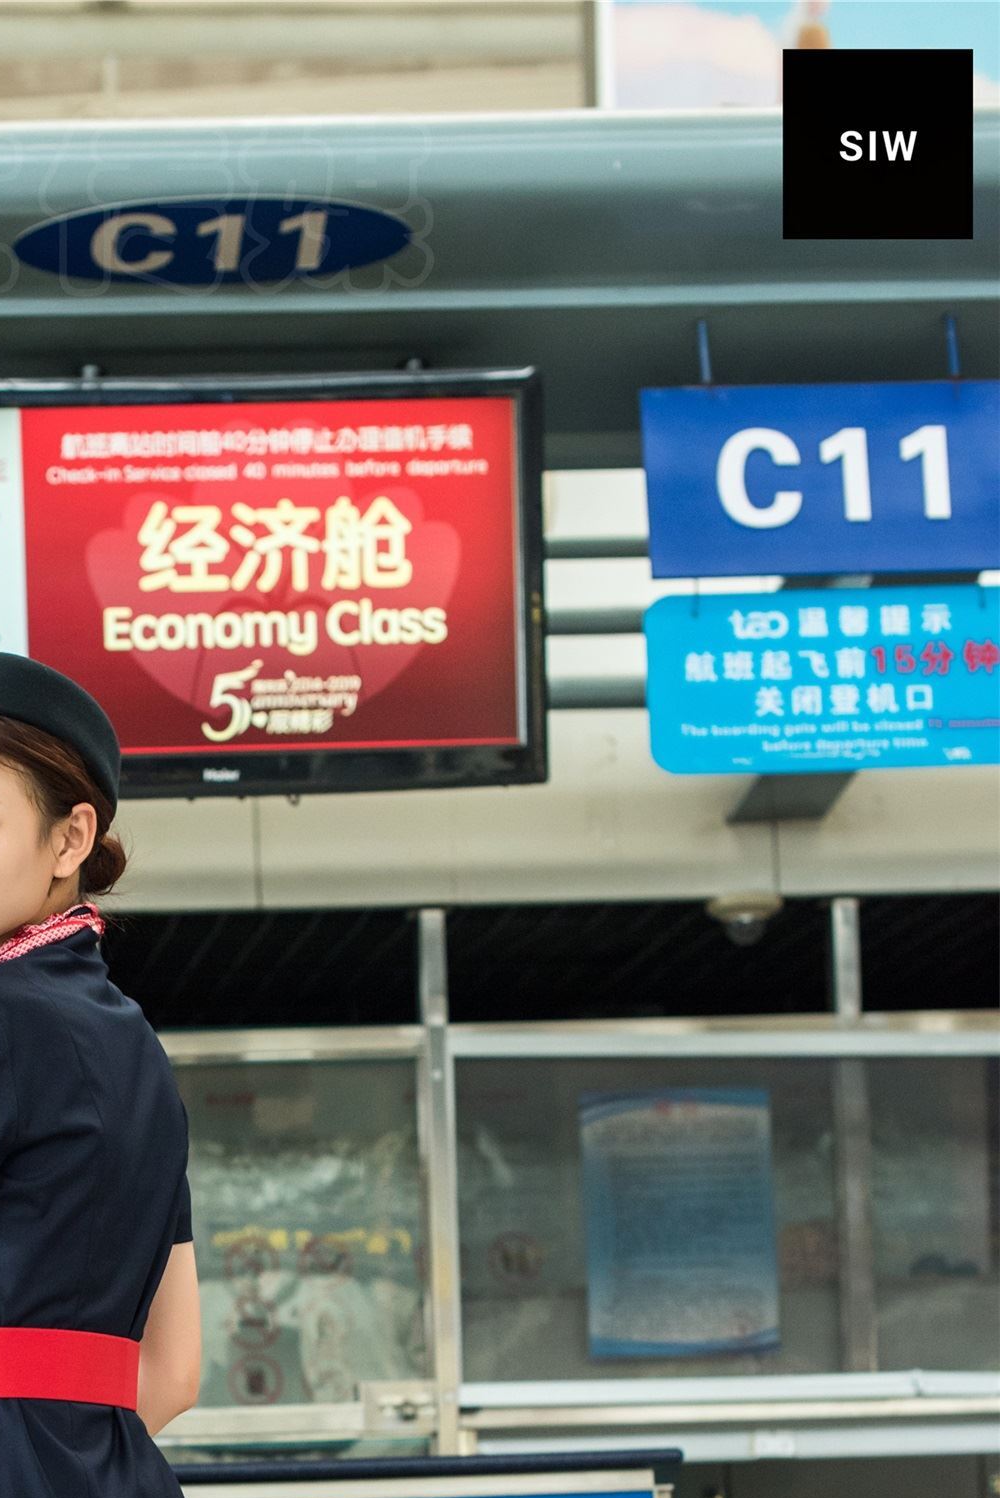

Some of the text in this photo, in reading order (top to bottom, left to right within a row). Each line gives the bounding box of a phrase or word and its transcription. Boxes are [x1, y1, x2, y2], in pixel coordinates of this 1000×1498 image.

[90, 210, 332, 274] C11
[45, 466, 122, 486] Check-in
[123, 464, 183, 483] Service
[242, 461, 268, 480] 40
[271, 461, 341, 479] minutes
[344, 458, 401, 478] before
[405, 457, 489, 478] departure
[715, 424, 952, 529] C11
[137, 496, 413, 593] 经济舱
[103, 598, 449, 655] Economy Class
[754, 682, 934, 718] 关闭登机口
[681, 723, 709, 737] The
[710, 722, 781, 738] boarding
